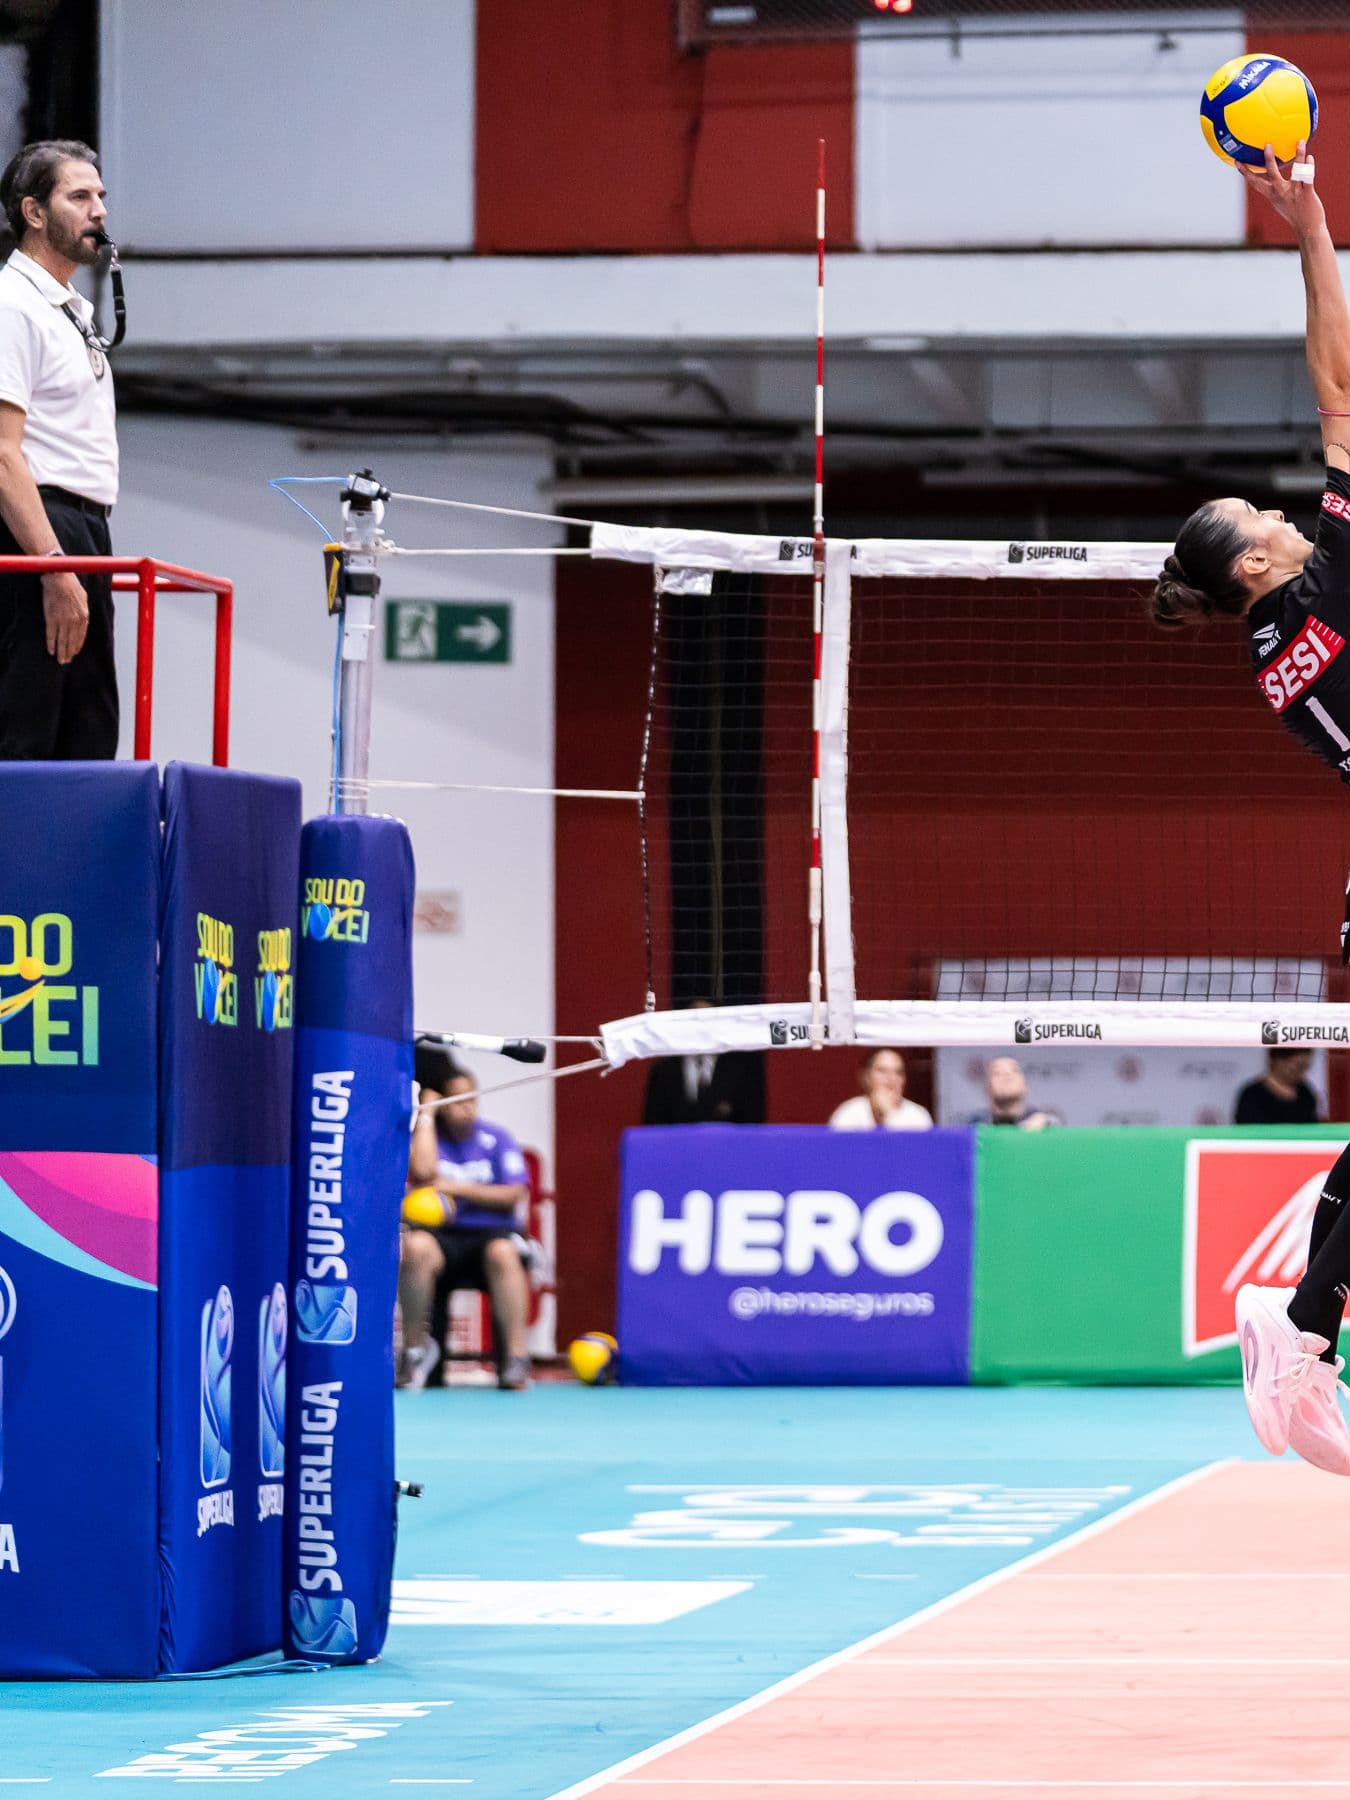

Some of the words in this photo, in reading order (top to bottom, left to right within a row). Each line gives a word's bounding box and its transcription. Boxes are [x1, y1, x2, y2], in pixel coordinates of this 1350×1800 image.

[1026, 544, 1087, 561] SUPERLIGA
[1264, 628, 1331, 708] SESI
[334, 879, 365, 905] DO
[1035, 1024, 1102, 1041] SUPERLIGA
[1282, 1026, 1349, 1043] SUPERLIGA
[306, 1070, 355, 1281] SUPERLIGA
[629, 1189, 944, 1278] HERO
[299, 1380, 344, 1592] SUPERLIGA
[91, 1700, 455, 1778] RECOMA
